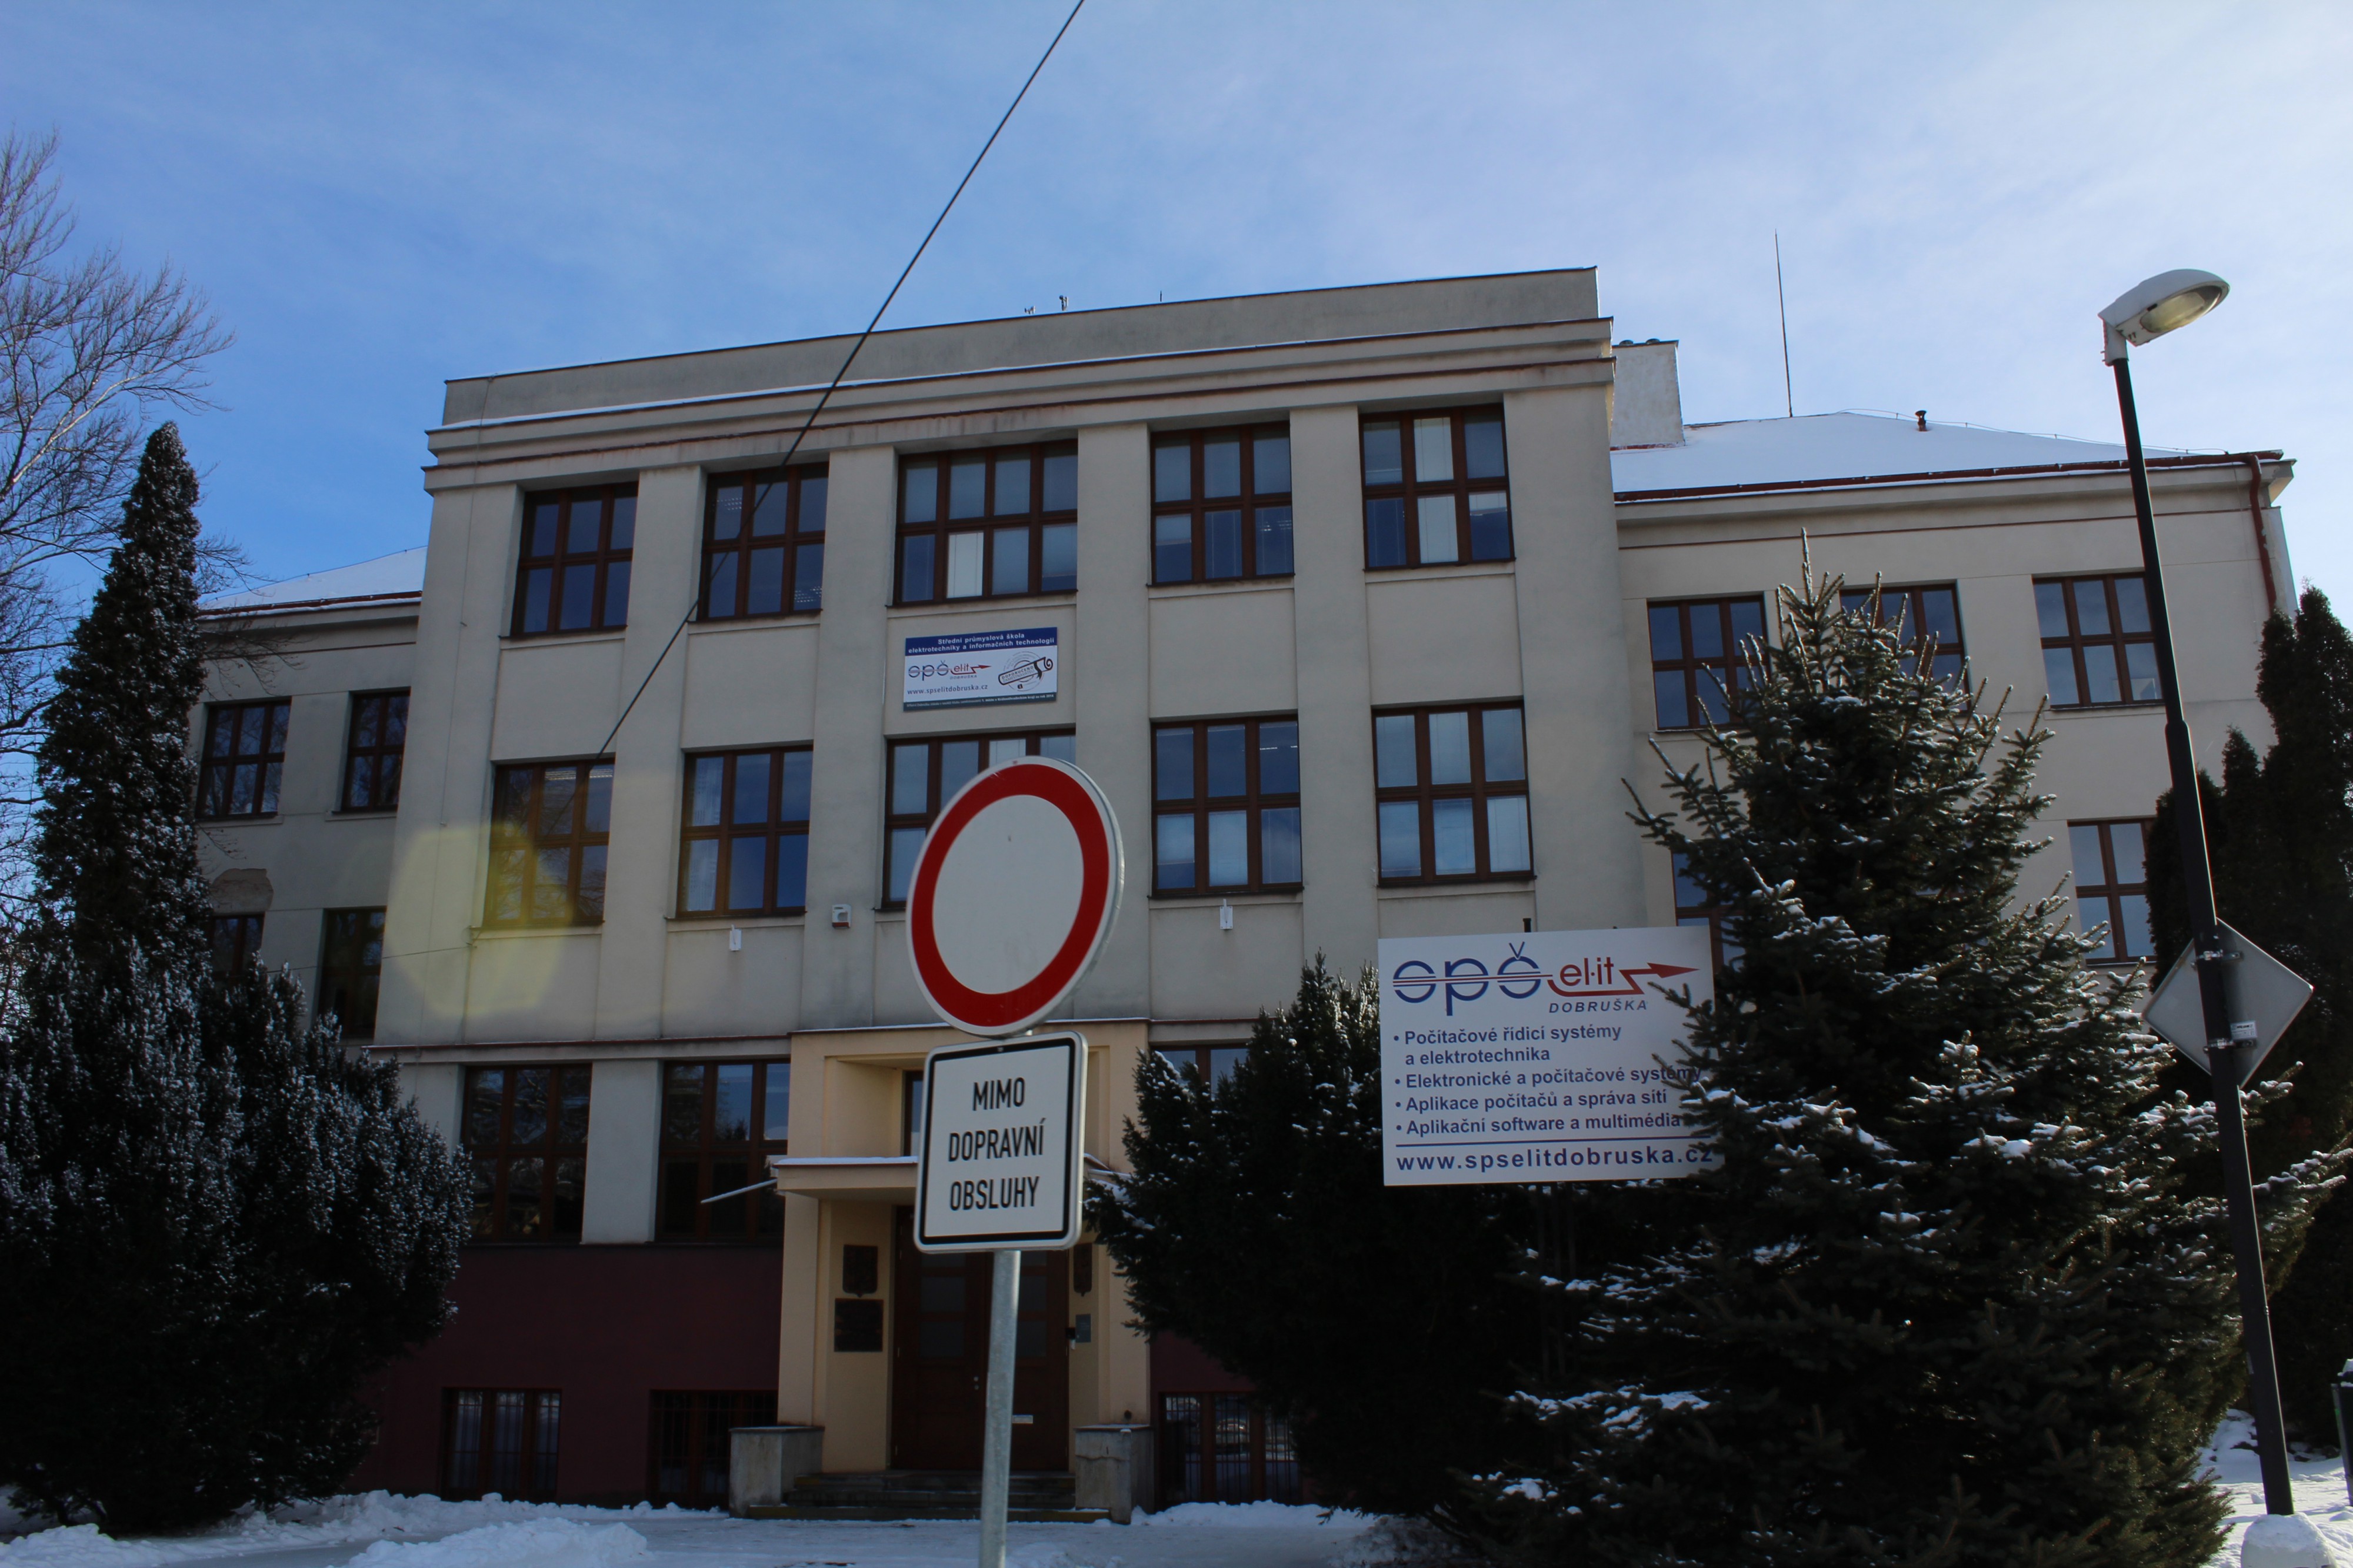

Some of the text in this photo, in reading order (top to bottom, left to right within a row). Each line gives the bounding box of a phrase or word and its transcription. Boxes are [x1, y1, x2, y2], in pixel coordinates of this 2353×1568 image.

[908, 645, 960, 653] elektrotechniky
[965, 634, 1004, 643] průmyslová
[907, 684, 988, 695] www.spselitdobruska.cz
[1549, 999, 1647, 1013] DOBRUŠKA
[1405, 1024, 1621, 1045] Počítačové řídicí systémy
[1405, 1047, 1550, 1065] a elektrotechnika
[1406, 1070, 1512, 1088] Elektronické
[1517, 1073, 1526, 1085] a
[1532, 1067, 1625, 1087] počítačové
[972, 1077, 1025, 1111] MIMO
[1406, 1089, 1667, 1114] Aplikace počítačů a správa sítí
[1407, 1113, 1681, 1137] Aplikační software a multimédia
[948, 1117, 1046, 1162] DOPRAVNÍ
[1396, 1146, 1712, 1173] www.spselitdobruska.cz
[950, 1176, 1040, 1211] OBSLUHY
